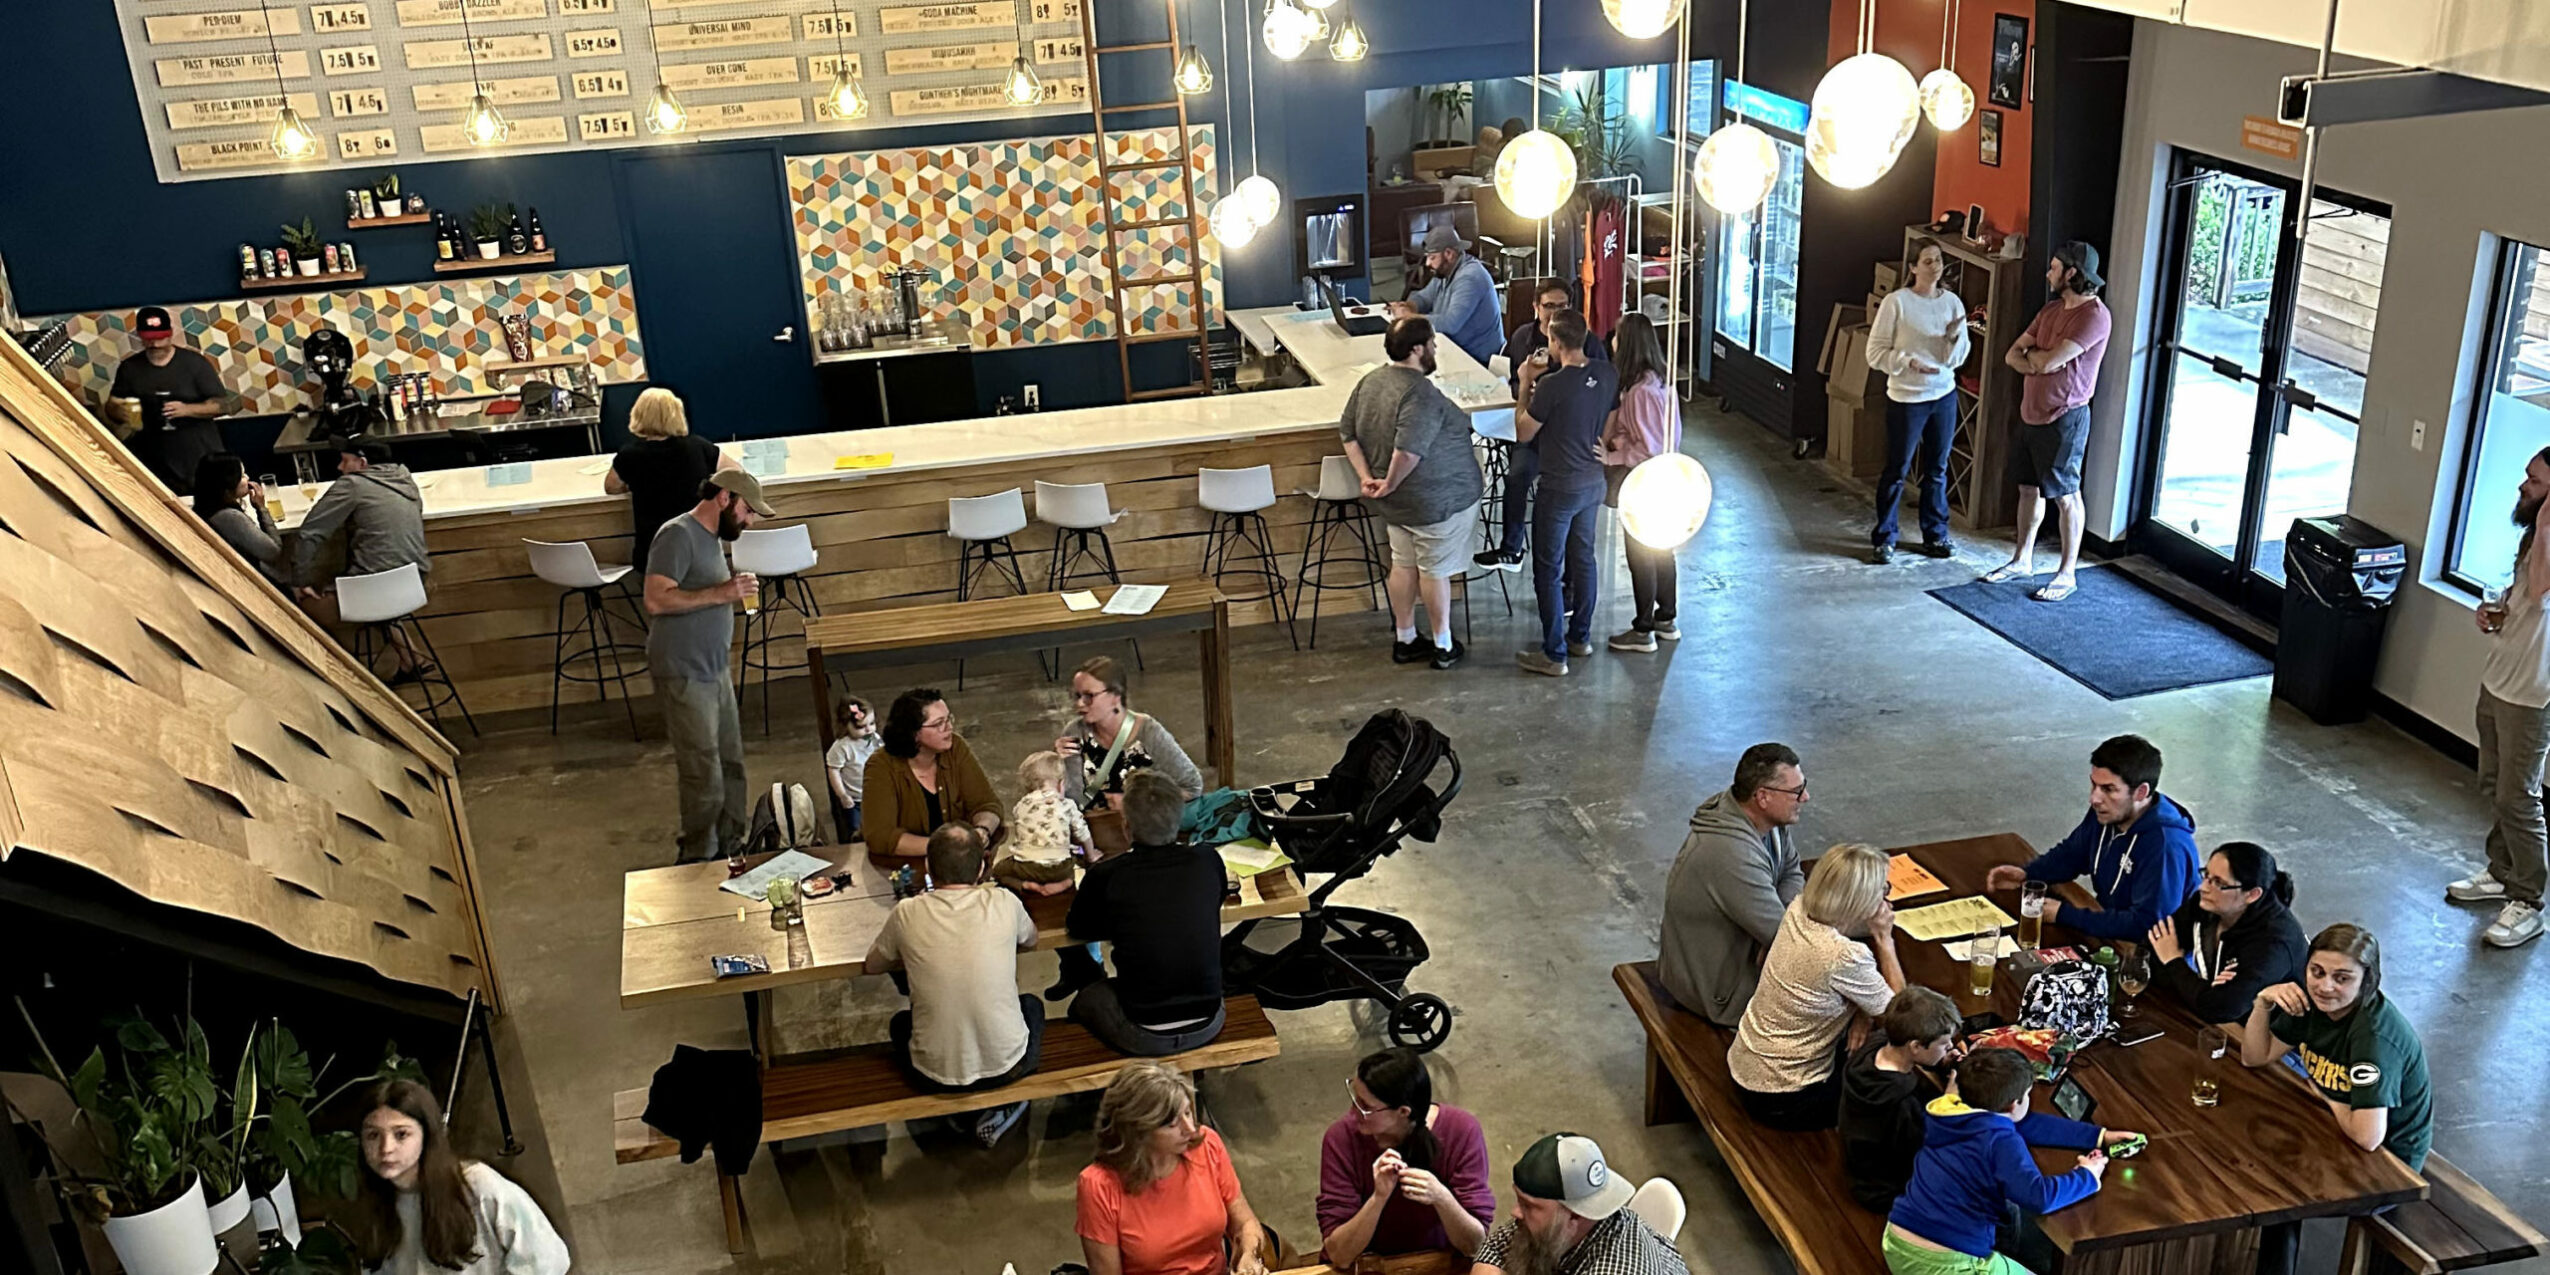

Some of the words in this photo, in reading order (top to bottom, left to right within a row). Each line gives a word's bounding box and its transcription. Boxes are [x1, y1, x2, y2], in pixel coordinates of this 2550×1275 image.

[944, 5, 978, 16] MACHINE
[1037, 5, 1043, 18] 8
[1064, 3, 1071, 16] 5
[318, 12, 325, 27] 7
[688, 24, 729, 35] UNIVERSAL
[732, 21, 751, 31] MIND
[1041, 46, 1047, 58] 7
[183, 60, 203, 70] PAST
[211, 57, 245, 68] PRESENT
[358, 53, 366, 66] 5
[706, 64, 726, 75] OVER
[608, 77, 614, 90] 4
[1044, 86, 1051, 99] 8
[1071, 84, 1078, 97] 5
[194, 102, 209, 113] THE
[211, 100, 230, 112] PILS
[231, 99, 252, 110] WITH
[254, 98, 265, 108] NO
[336, 96, 343, 110] 7
[819, 102, 827, 116] 8
[612, 118, 619, 131] 5
[211, 143, 237, 154] BLACK
[345, 138, 353, 152] 8
[375, 136, 383, 149] 6
[2350, 1062, 2381, 1087] G
